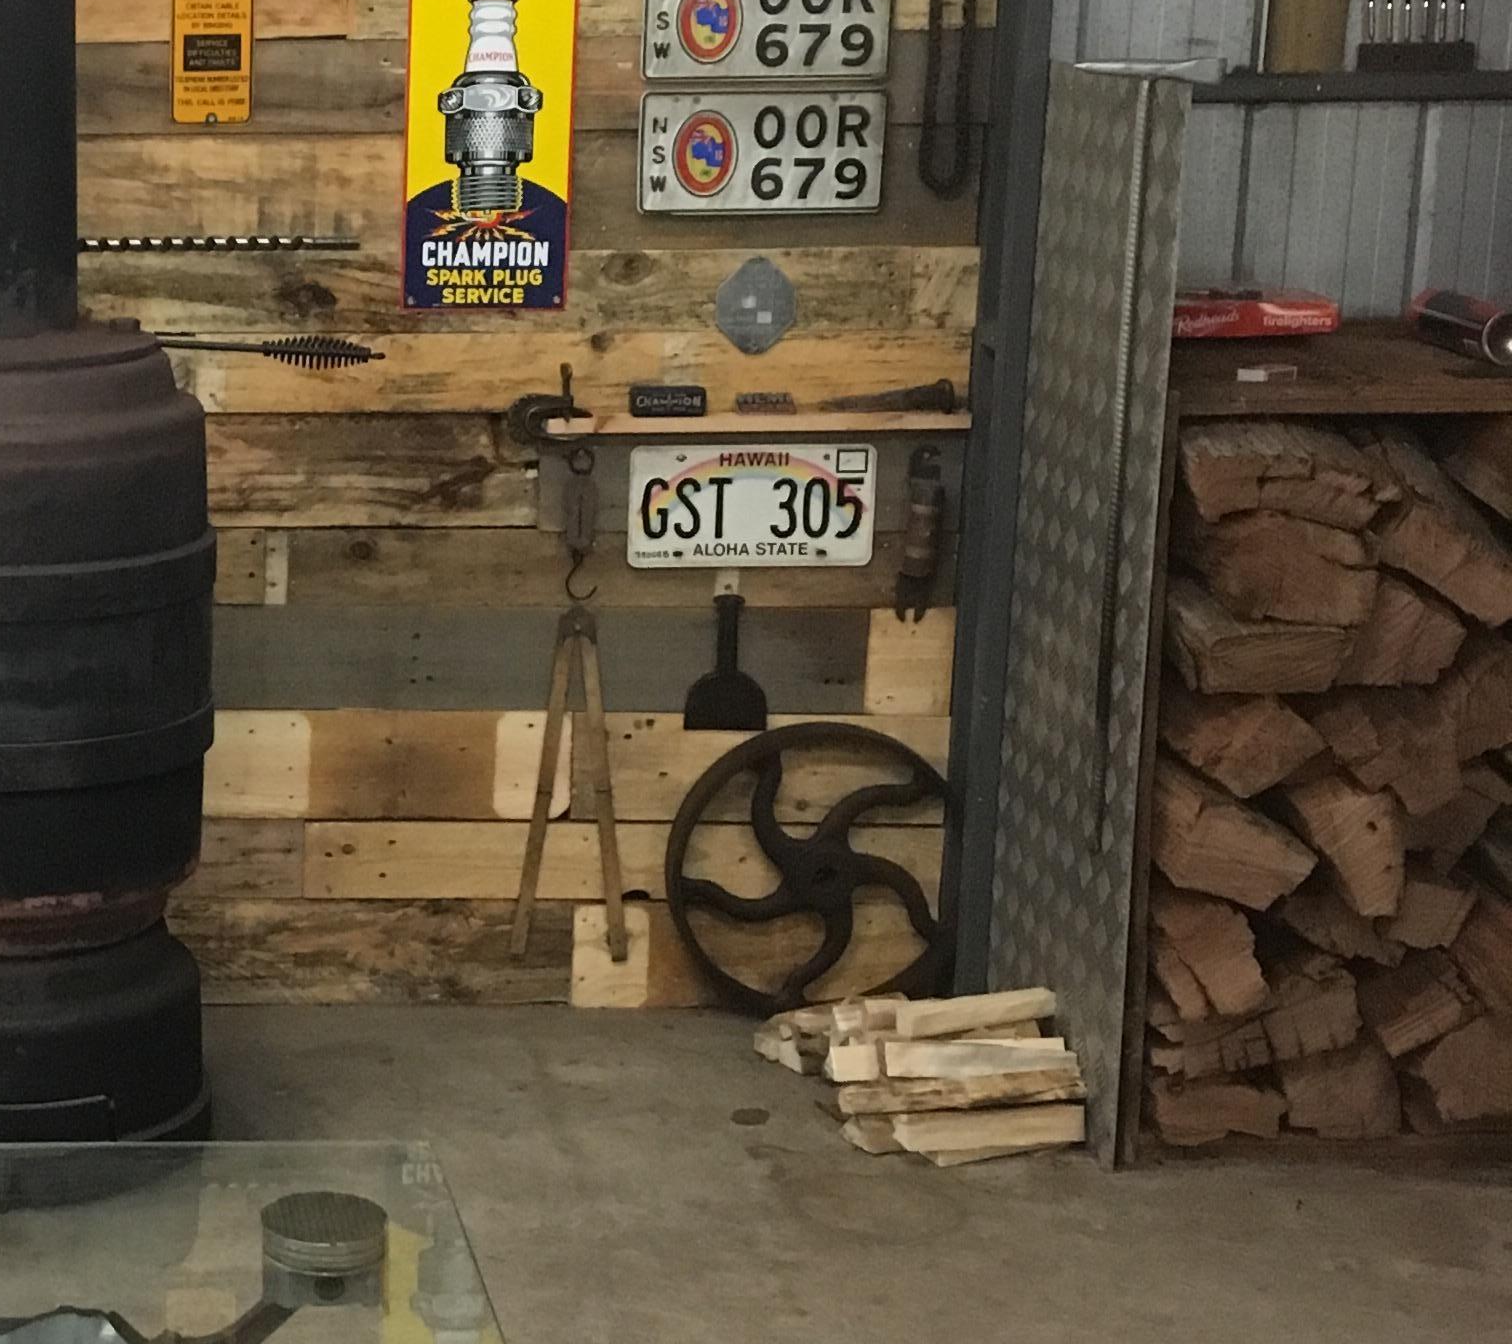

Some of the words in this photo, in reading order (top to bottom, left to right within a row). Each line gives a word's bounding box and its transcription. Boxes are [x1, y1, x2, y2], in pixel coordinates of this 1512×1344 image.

[755, 23, 874, 68] 679
[468, 51, 514, 63] CHAMPION
[751, 158, 867, 201] 679
[421, 241, 549, 267] CHAMPION
[426, 268, 487, 286] SPARK
[493, 268, 543, 286] PLUG
[442, 288, 525, 304] SERVICE
[1263, 315, 1333, 329] firelighters
[719, 452, 790, 467] HAWAII
[641, 477, 733, 539] GST
[770, 477, 865, 539] 305
[693, 543, 749, 557] ALOHA
[755, 542, 808, 556] STATE
